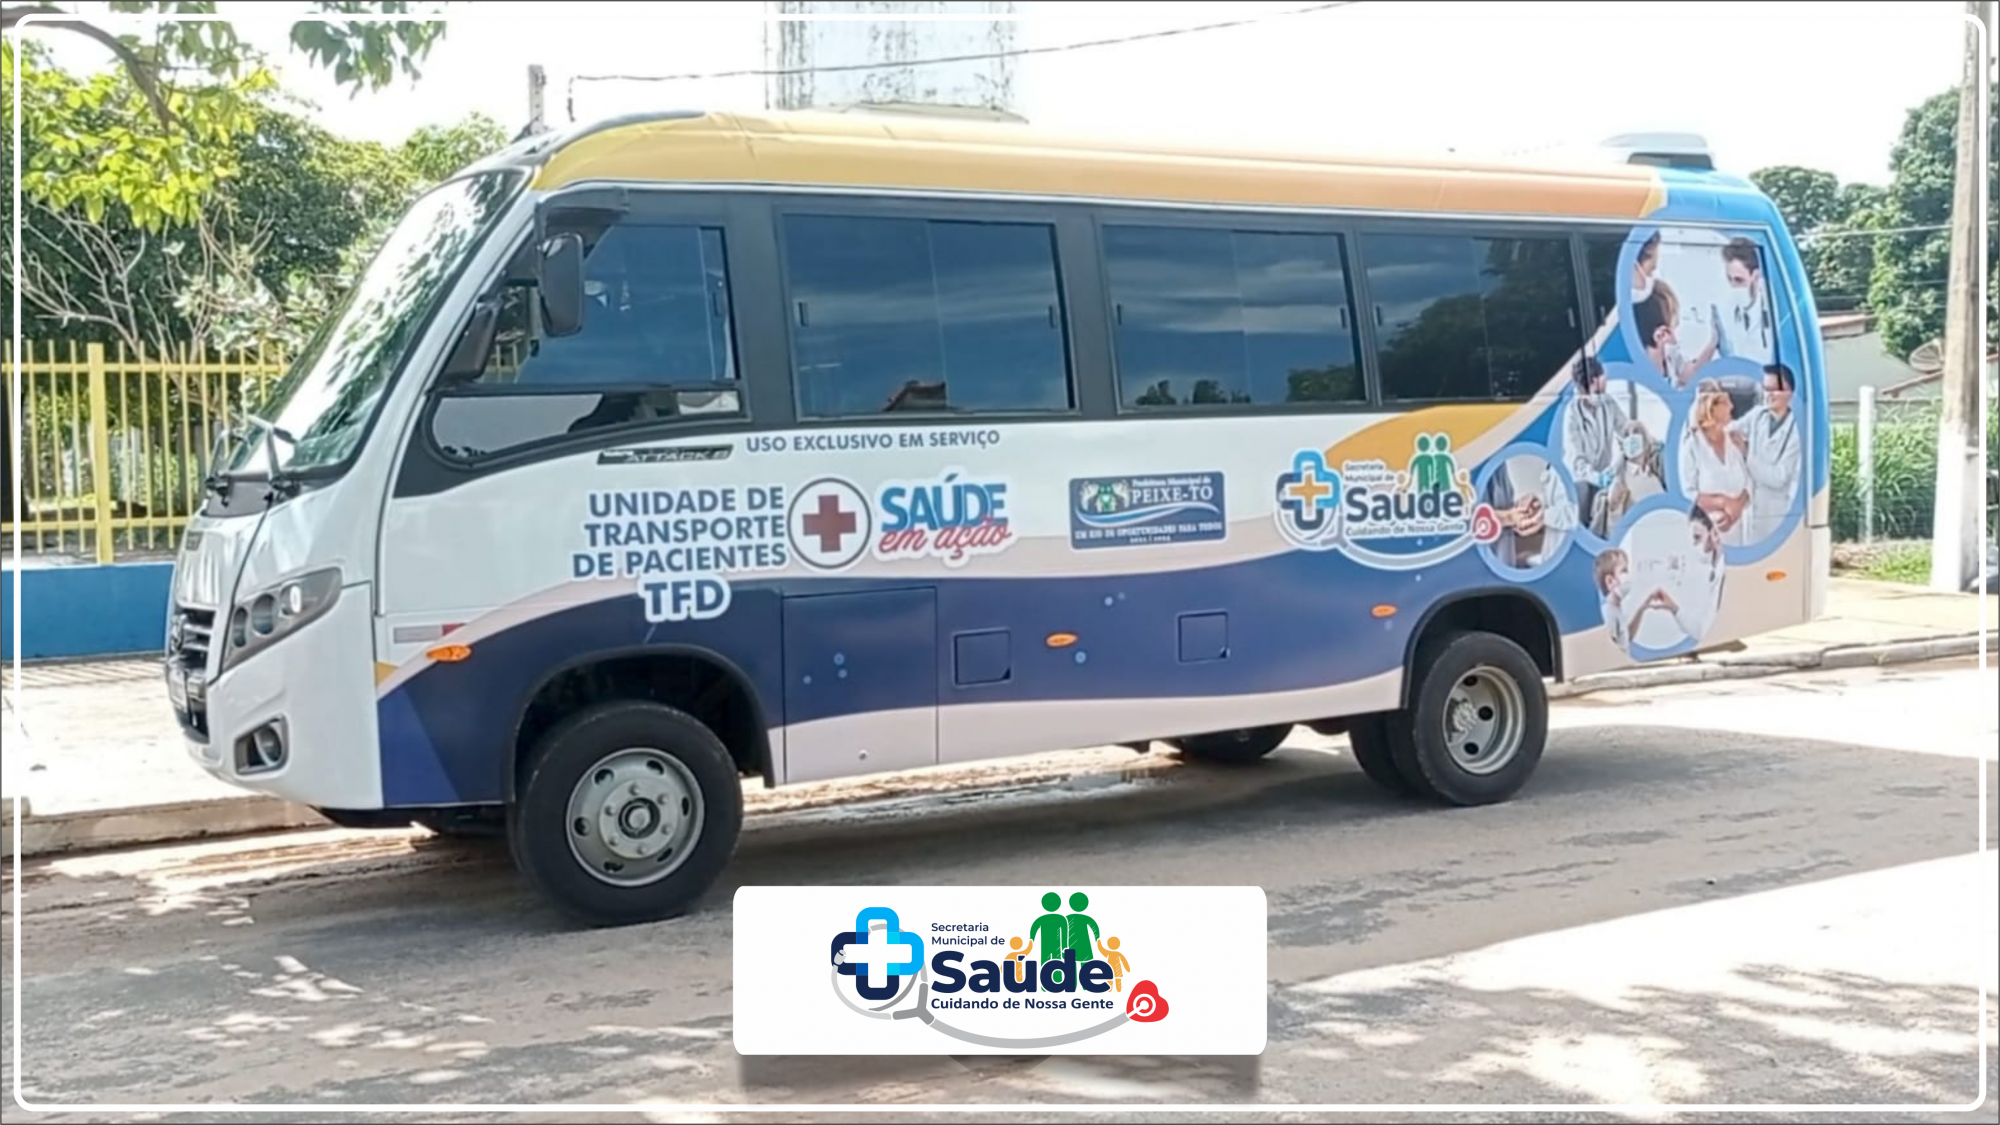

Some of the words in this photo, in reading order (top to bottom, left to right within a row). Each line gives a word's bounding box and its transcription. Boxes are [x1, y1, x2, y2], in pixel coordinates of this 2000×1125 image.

[746, 436, 787, 453] USO
[793, 433, 893, 451] EXCLUSIVO
[898, 432, 924, 448] EM
[929, 429, 1000, 449] SERVIÇO
[589, 488, 736, 518] UNIDADE
[747, 486, 784, 511] DE
[881, 473, 1009, 532] SAÚDE
[1132, 485, 1214, 505] PEIXE-TO
[584, 515, 786, 548] TRANSPORTE
[878, 527, 928, 553] em
[933, 517, 1012, 560] ação
[573, 552, 614, 578] DE
[626, 543, 787, 575] PACIENTES
[644, 579, 725, 616] TFD
